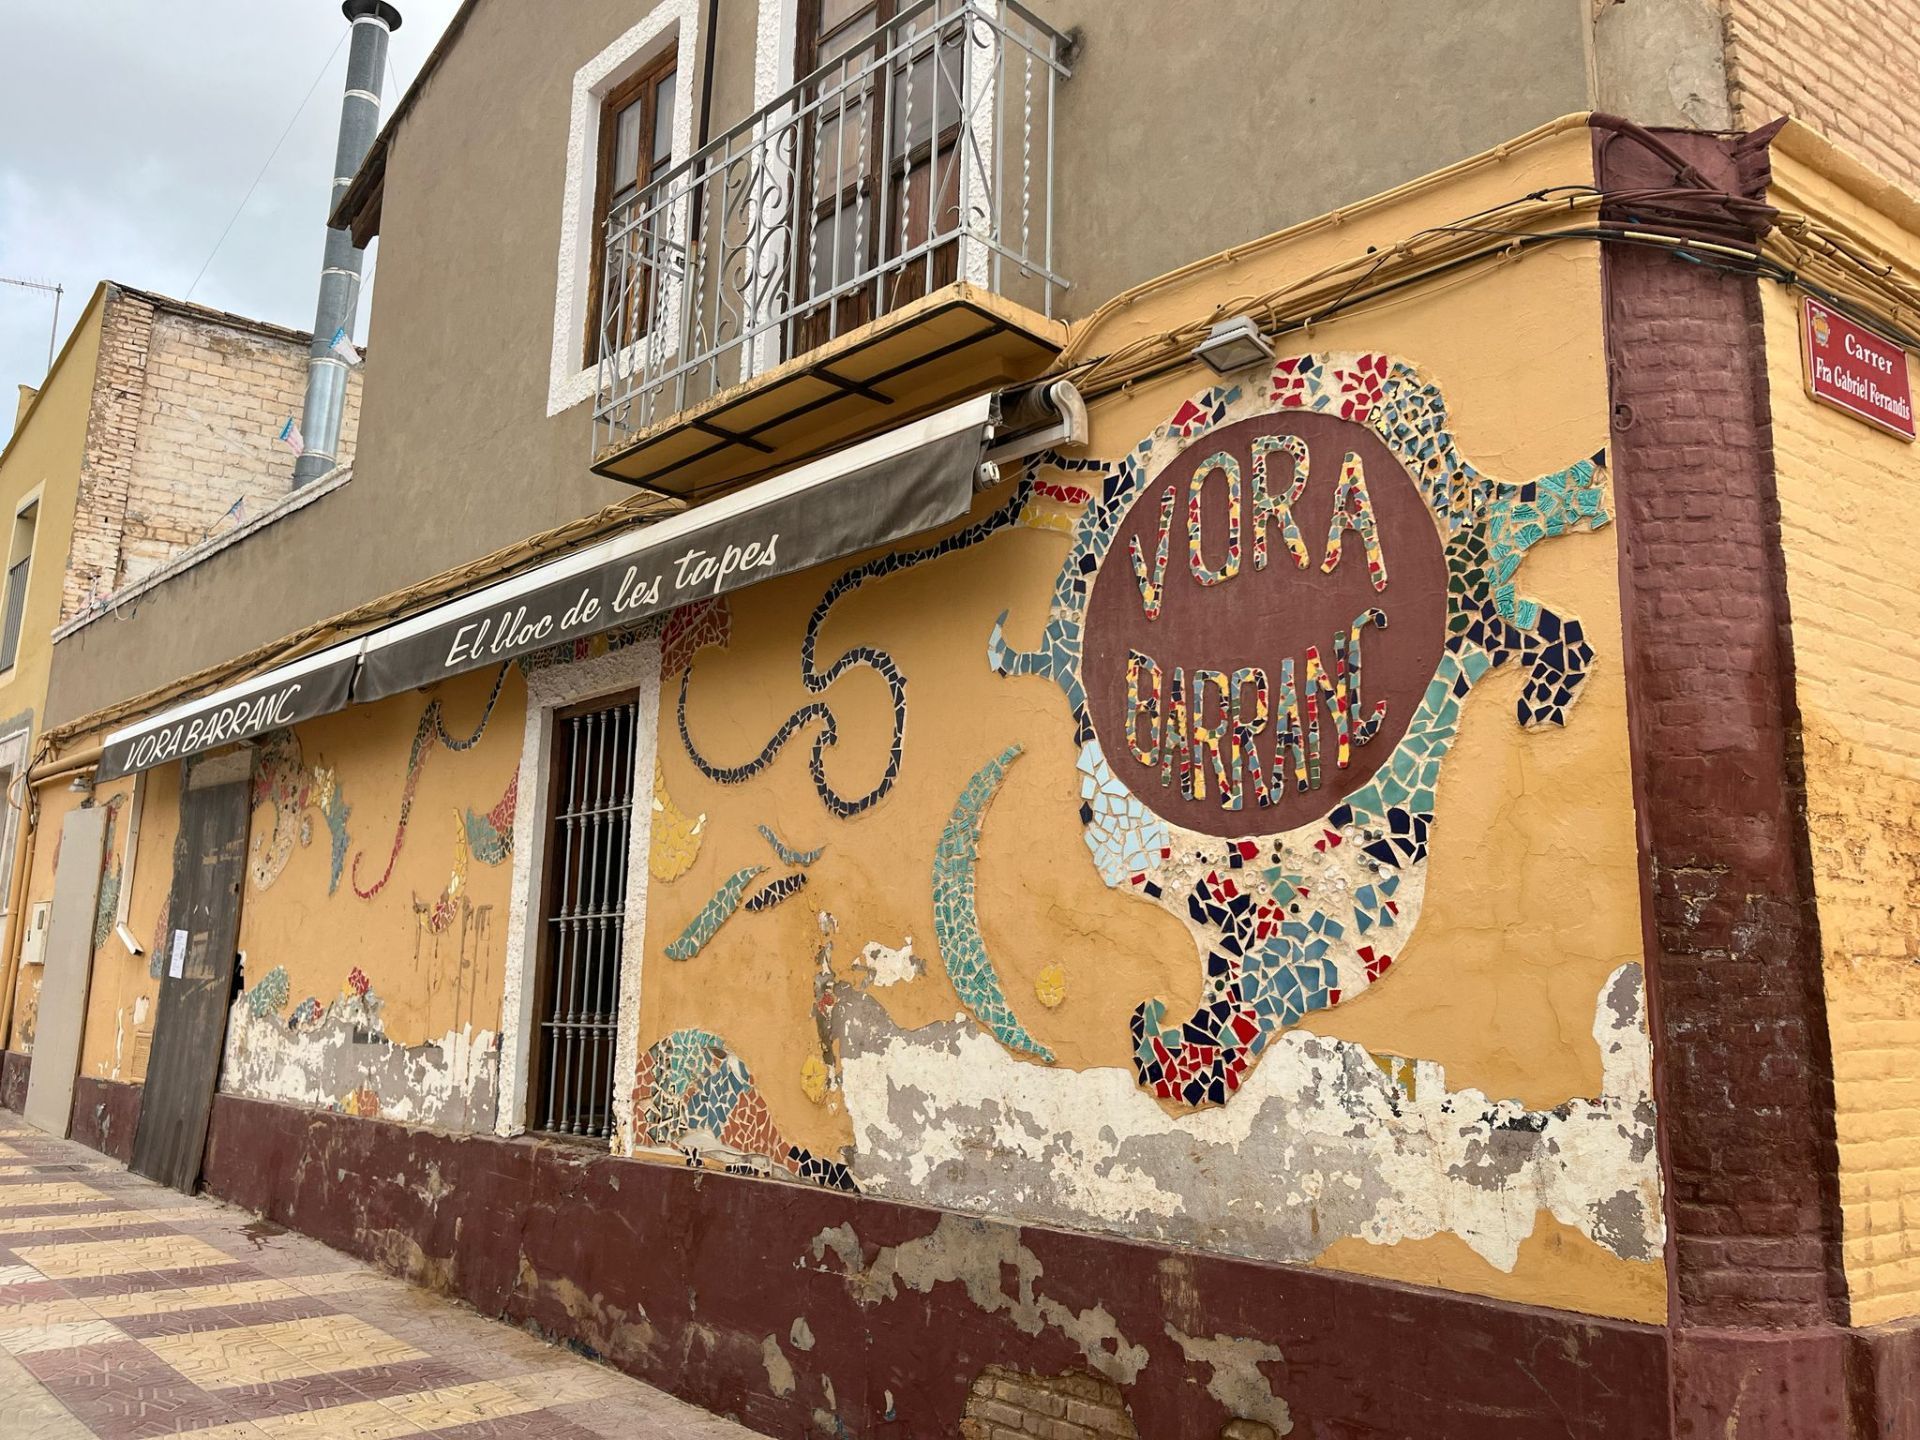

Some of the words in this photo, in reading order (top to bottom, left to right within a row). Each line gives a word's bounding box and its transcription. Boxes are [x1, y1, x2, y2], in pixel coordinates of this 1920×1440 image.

[1816, 357, 1832, 384] Fra
[1834, 365, 1868, 400] Gabriel
[1869, 382, 1910, 421] Ferrandis
[1845, 333, 1893, 375] Carrer
[1129, 434, 1387, 621] VORA
[445, 618, 490, 667] El
[491, 606, 553, 655] lloc
[560, 588, 601, 630] de
[612, 565, 661, 613] les
[674, 534, 779, 594] tapes
[123, 724, 184, 771] VORA
[181, 684, 301, 753] BARRANC
[1126, 607, 1387, 811] BARRANC
